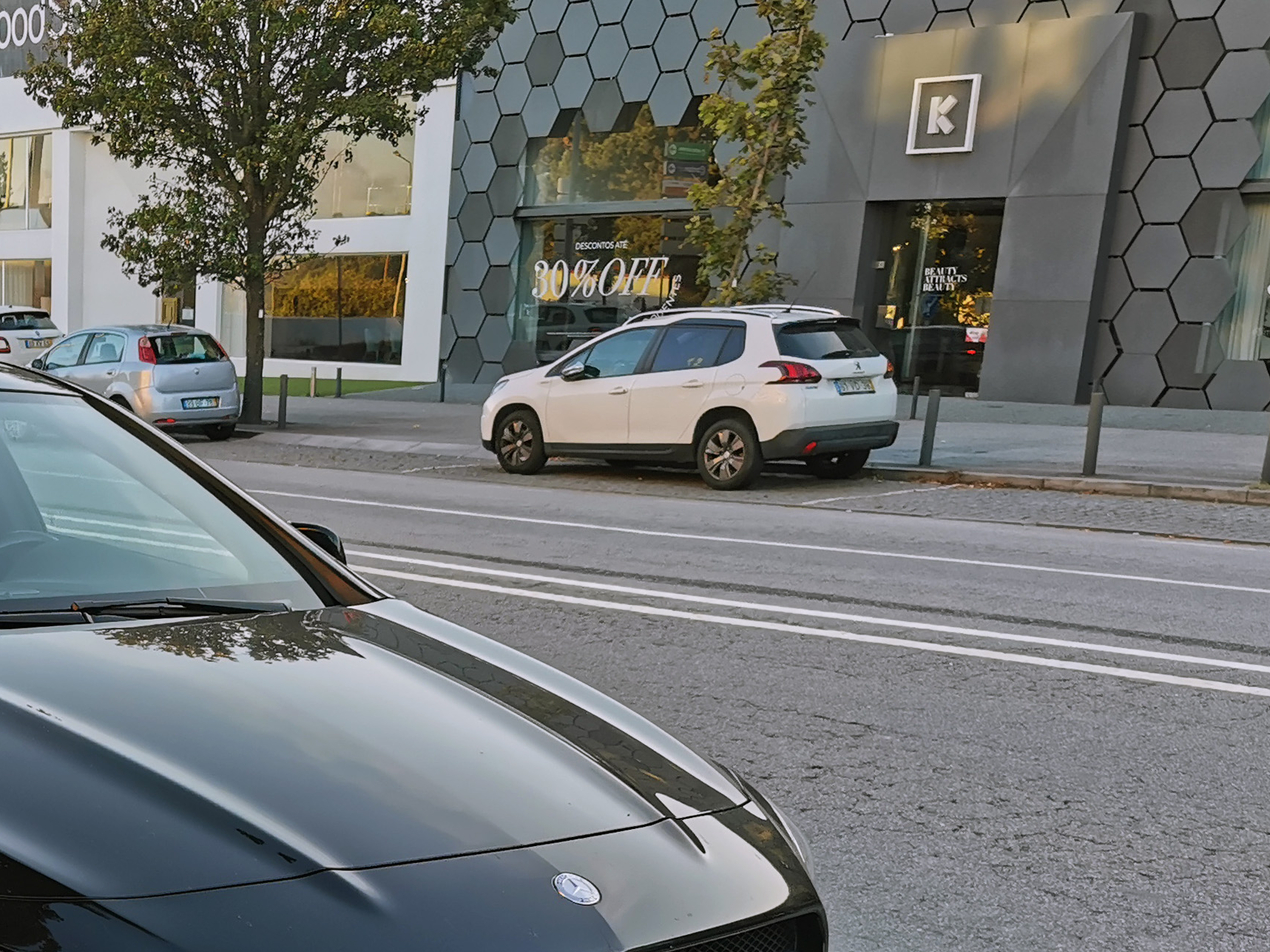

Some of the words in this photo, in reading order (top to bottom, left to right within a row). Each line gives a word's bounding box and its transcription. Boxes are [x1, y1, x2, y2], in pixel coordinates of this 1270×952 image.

[927, 94, 959, 135] K
[575, 241, 615, 250] DESCONTOS
[615, 240, 629, 249] ATÉ
[924, 266, 958, 276] BEAUTY
[924, 274, 968, 284] ATTRACTS
[922, 282, 955, 292] BEAUTY
